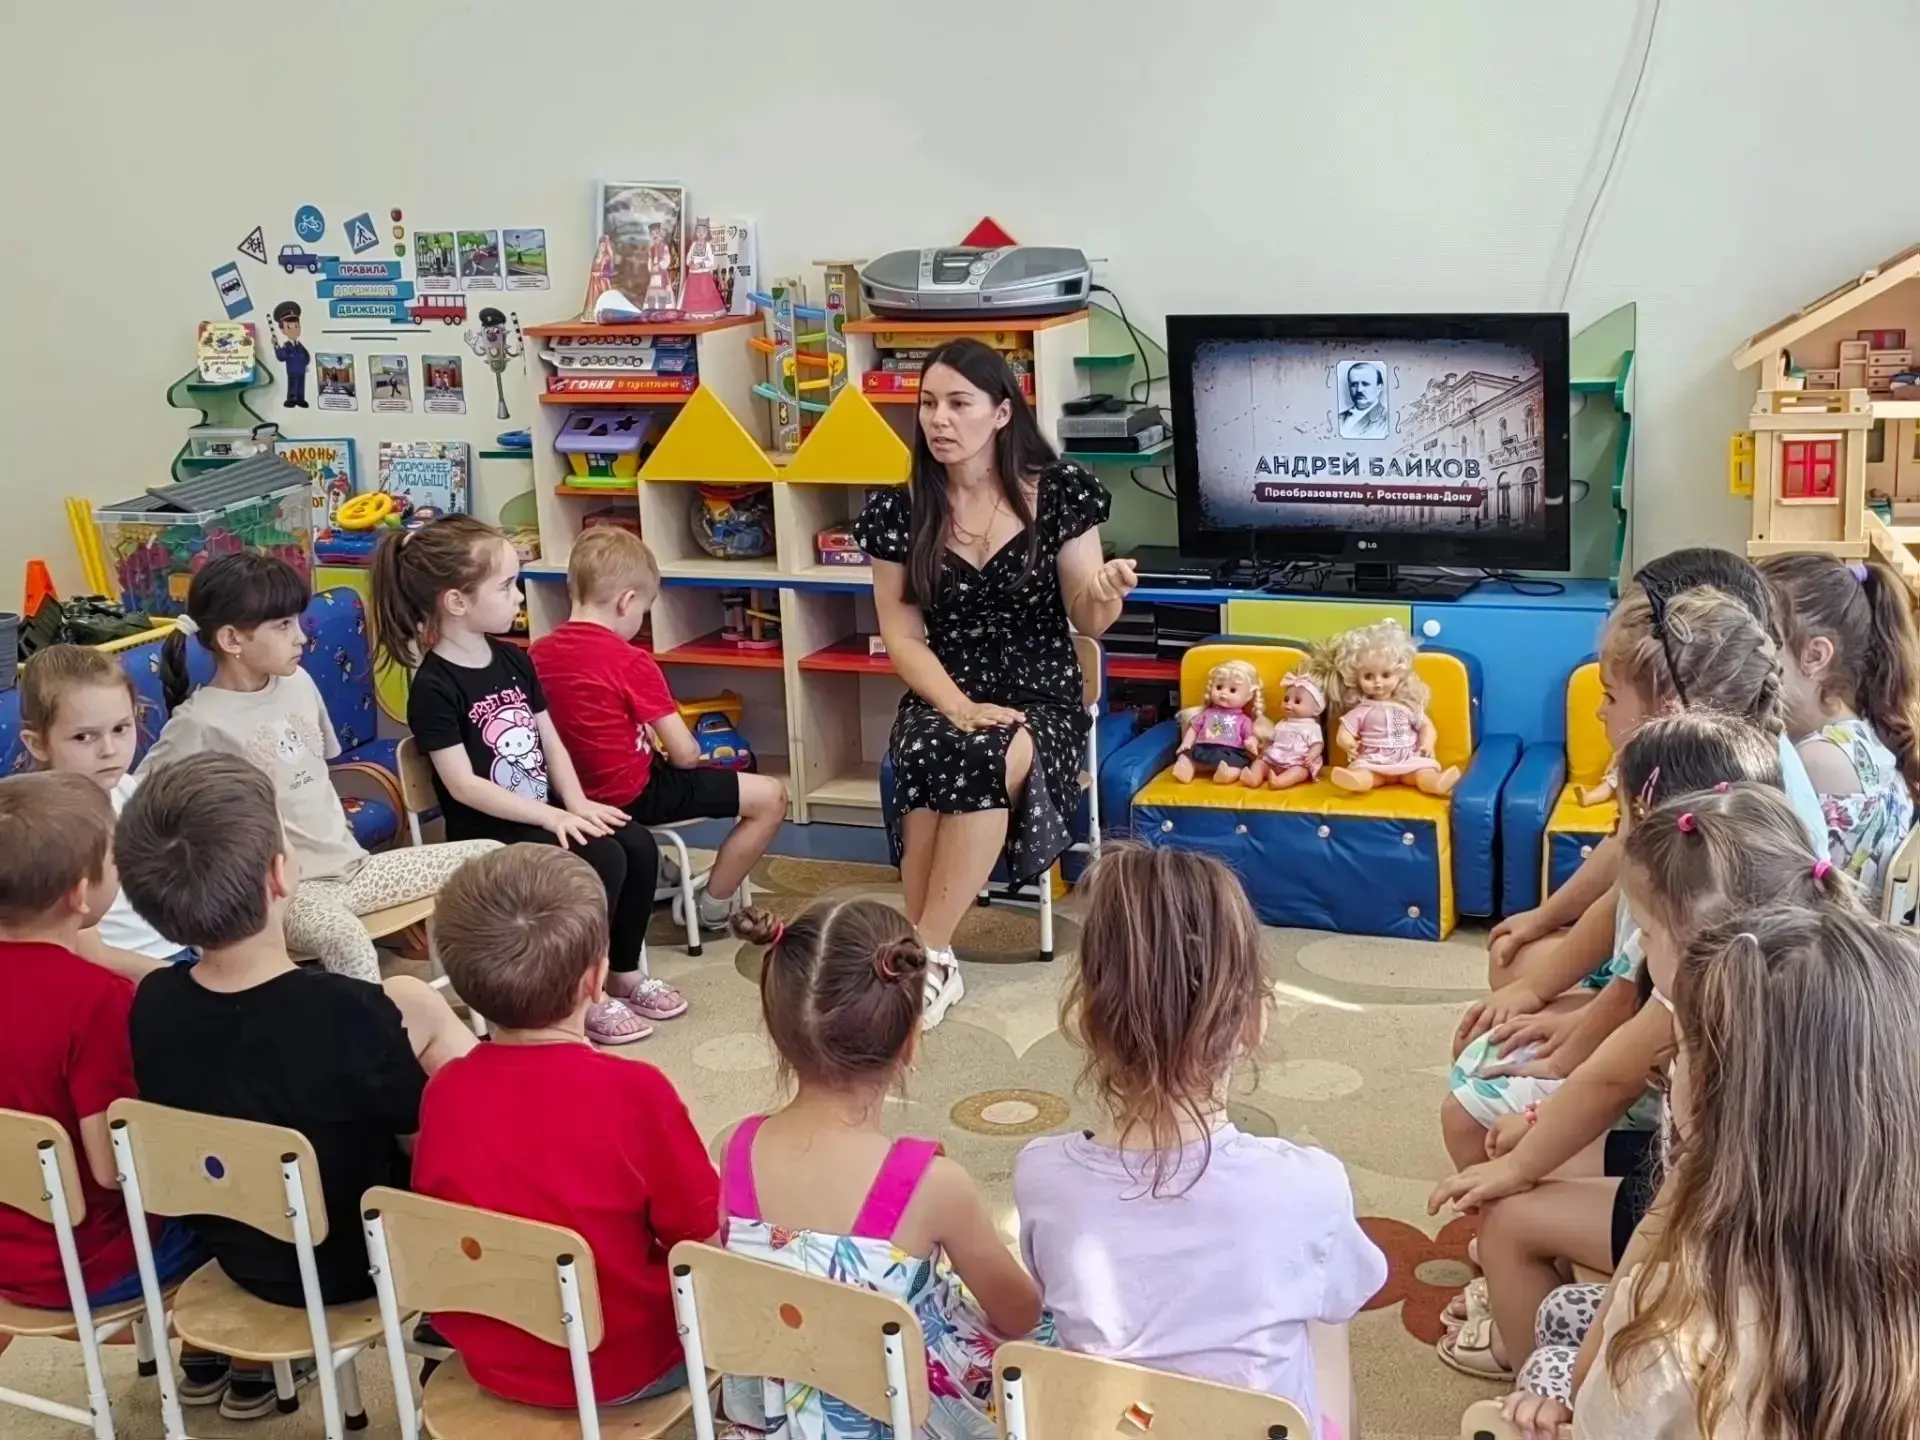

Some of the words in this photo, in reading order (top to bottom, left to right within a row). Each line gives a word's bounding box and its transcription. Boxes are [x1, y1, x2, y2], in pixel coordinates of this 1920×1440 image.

[340, 264, 387, 275] ПРАВИЛА
[334, 285, 397, 296] ДОРОЖНОГО
[338, 305, 396, 315] ДВИЖЕНИЯ
[569, 380, 615, 389] ГОНКИ
[1254, 452, 1360, 477] АНДРЕЙ
[1369, 453, 1481, 479] БАЙКОВ
[1264, 487, 1363, 499] Преобразователь
[1377, 490, 1472, 502] Ростова-на-Дону
[468, 694, 500, 723] STREET
